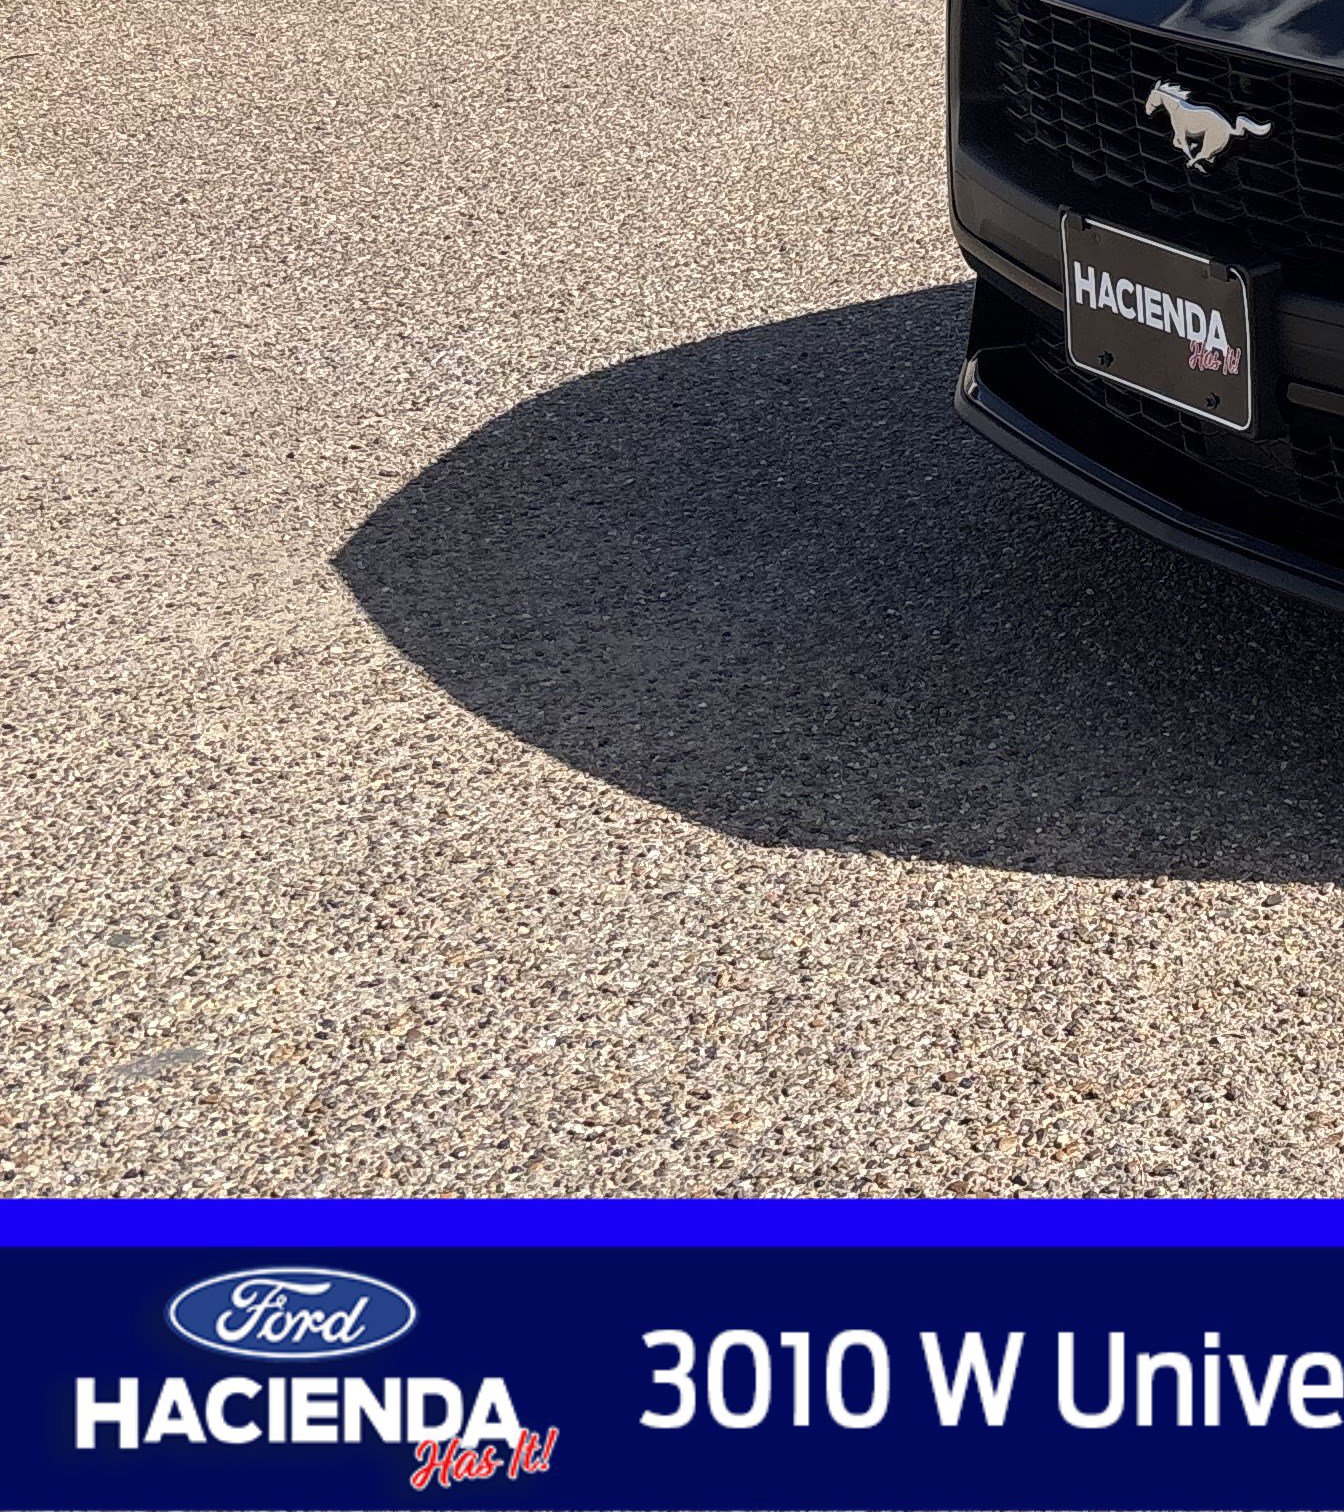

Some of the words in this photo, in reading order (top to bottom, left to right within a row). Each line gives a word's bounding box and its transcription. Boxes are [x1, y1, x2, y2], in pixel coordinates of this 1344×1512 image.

[1073, 260, 1229, 358] HACIENDA
[1188, 340, 1222, 371] Has
[1222, 344, 1242, 376] It!
